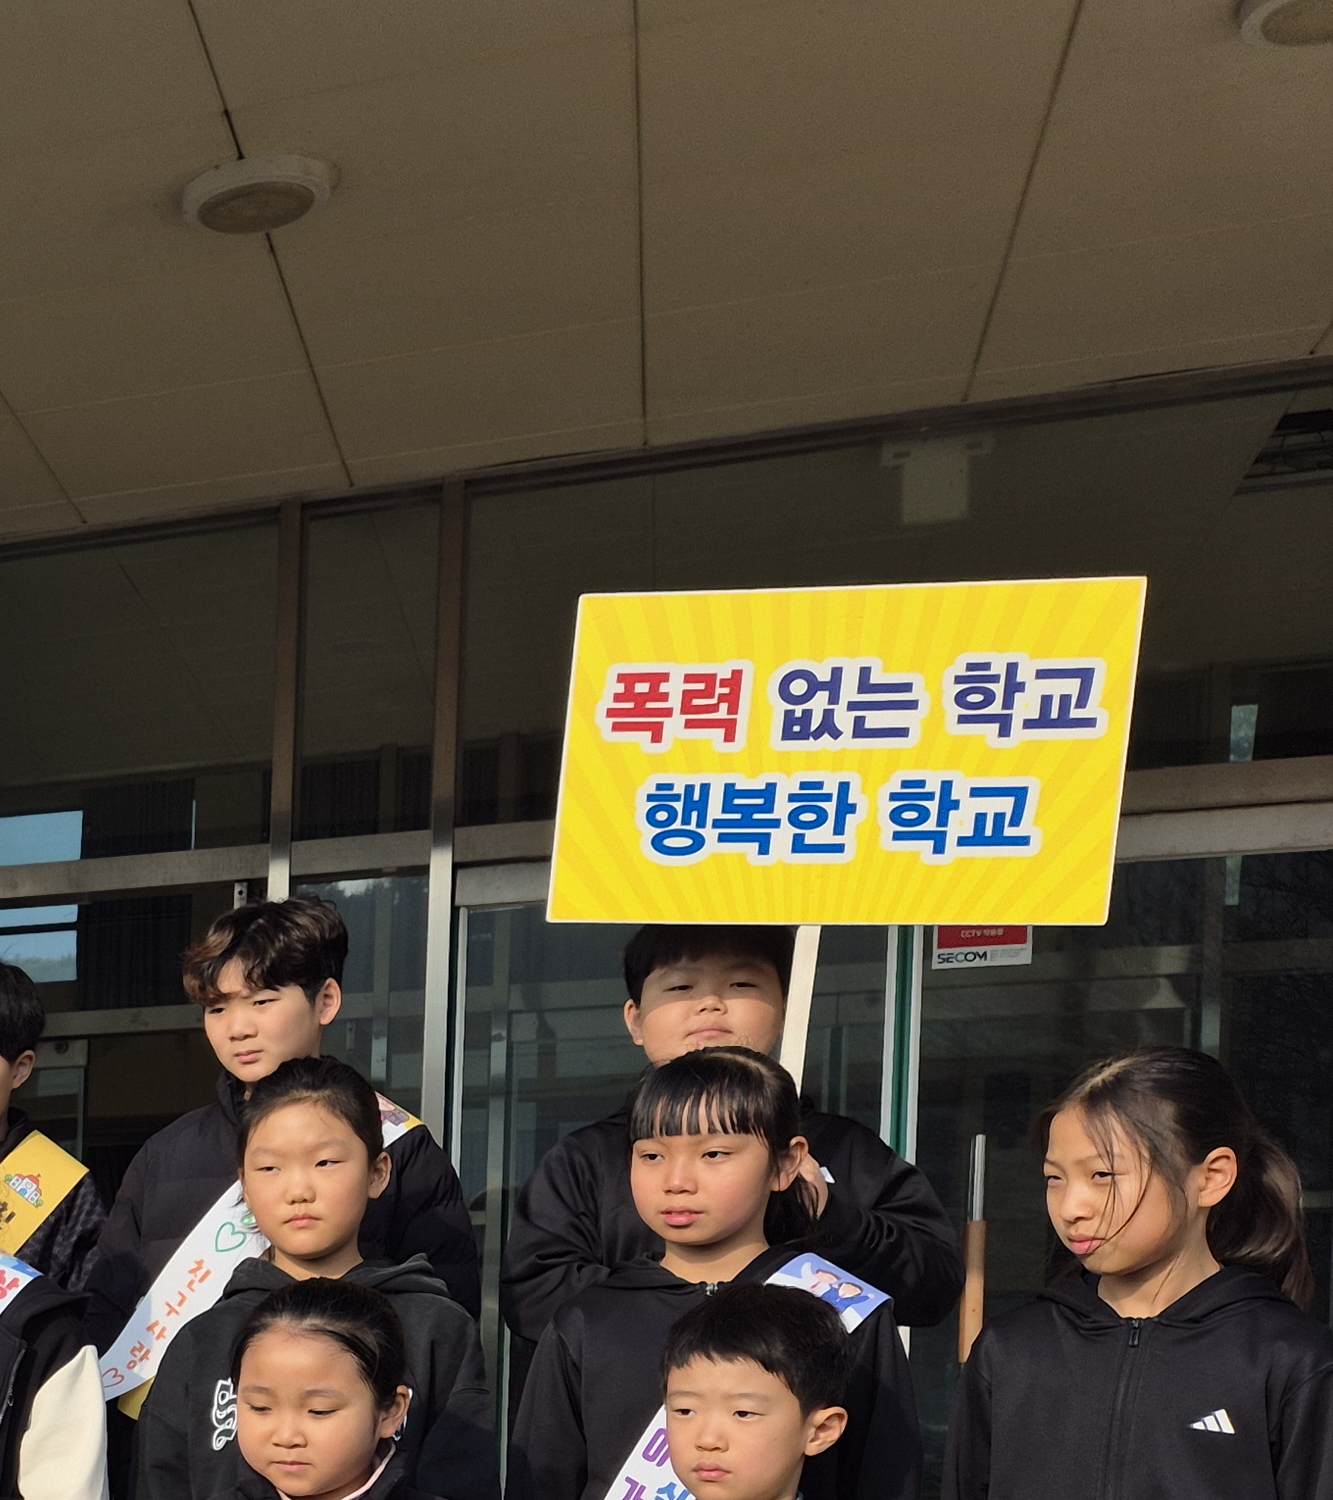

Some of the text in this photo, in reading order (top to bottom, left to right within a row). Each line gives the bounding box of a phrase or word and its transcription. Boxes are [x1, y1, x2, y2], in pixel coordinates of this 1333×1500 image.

[605, 660, 1098, 744] 폭력 없는 학교
[644, 777, 1032, 857] 행복한 학교
[937, 951, 988, 965] SECOM
